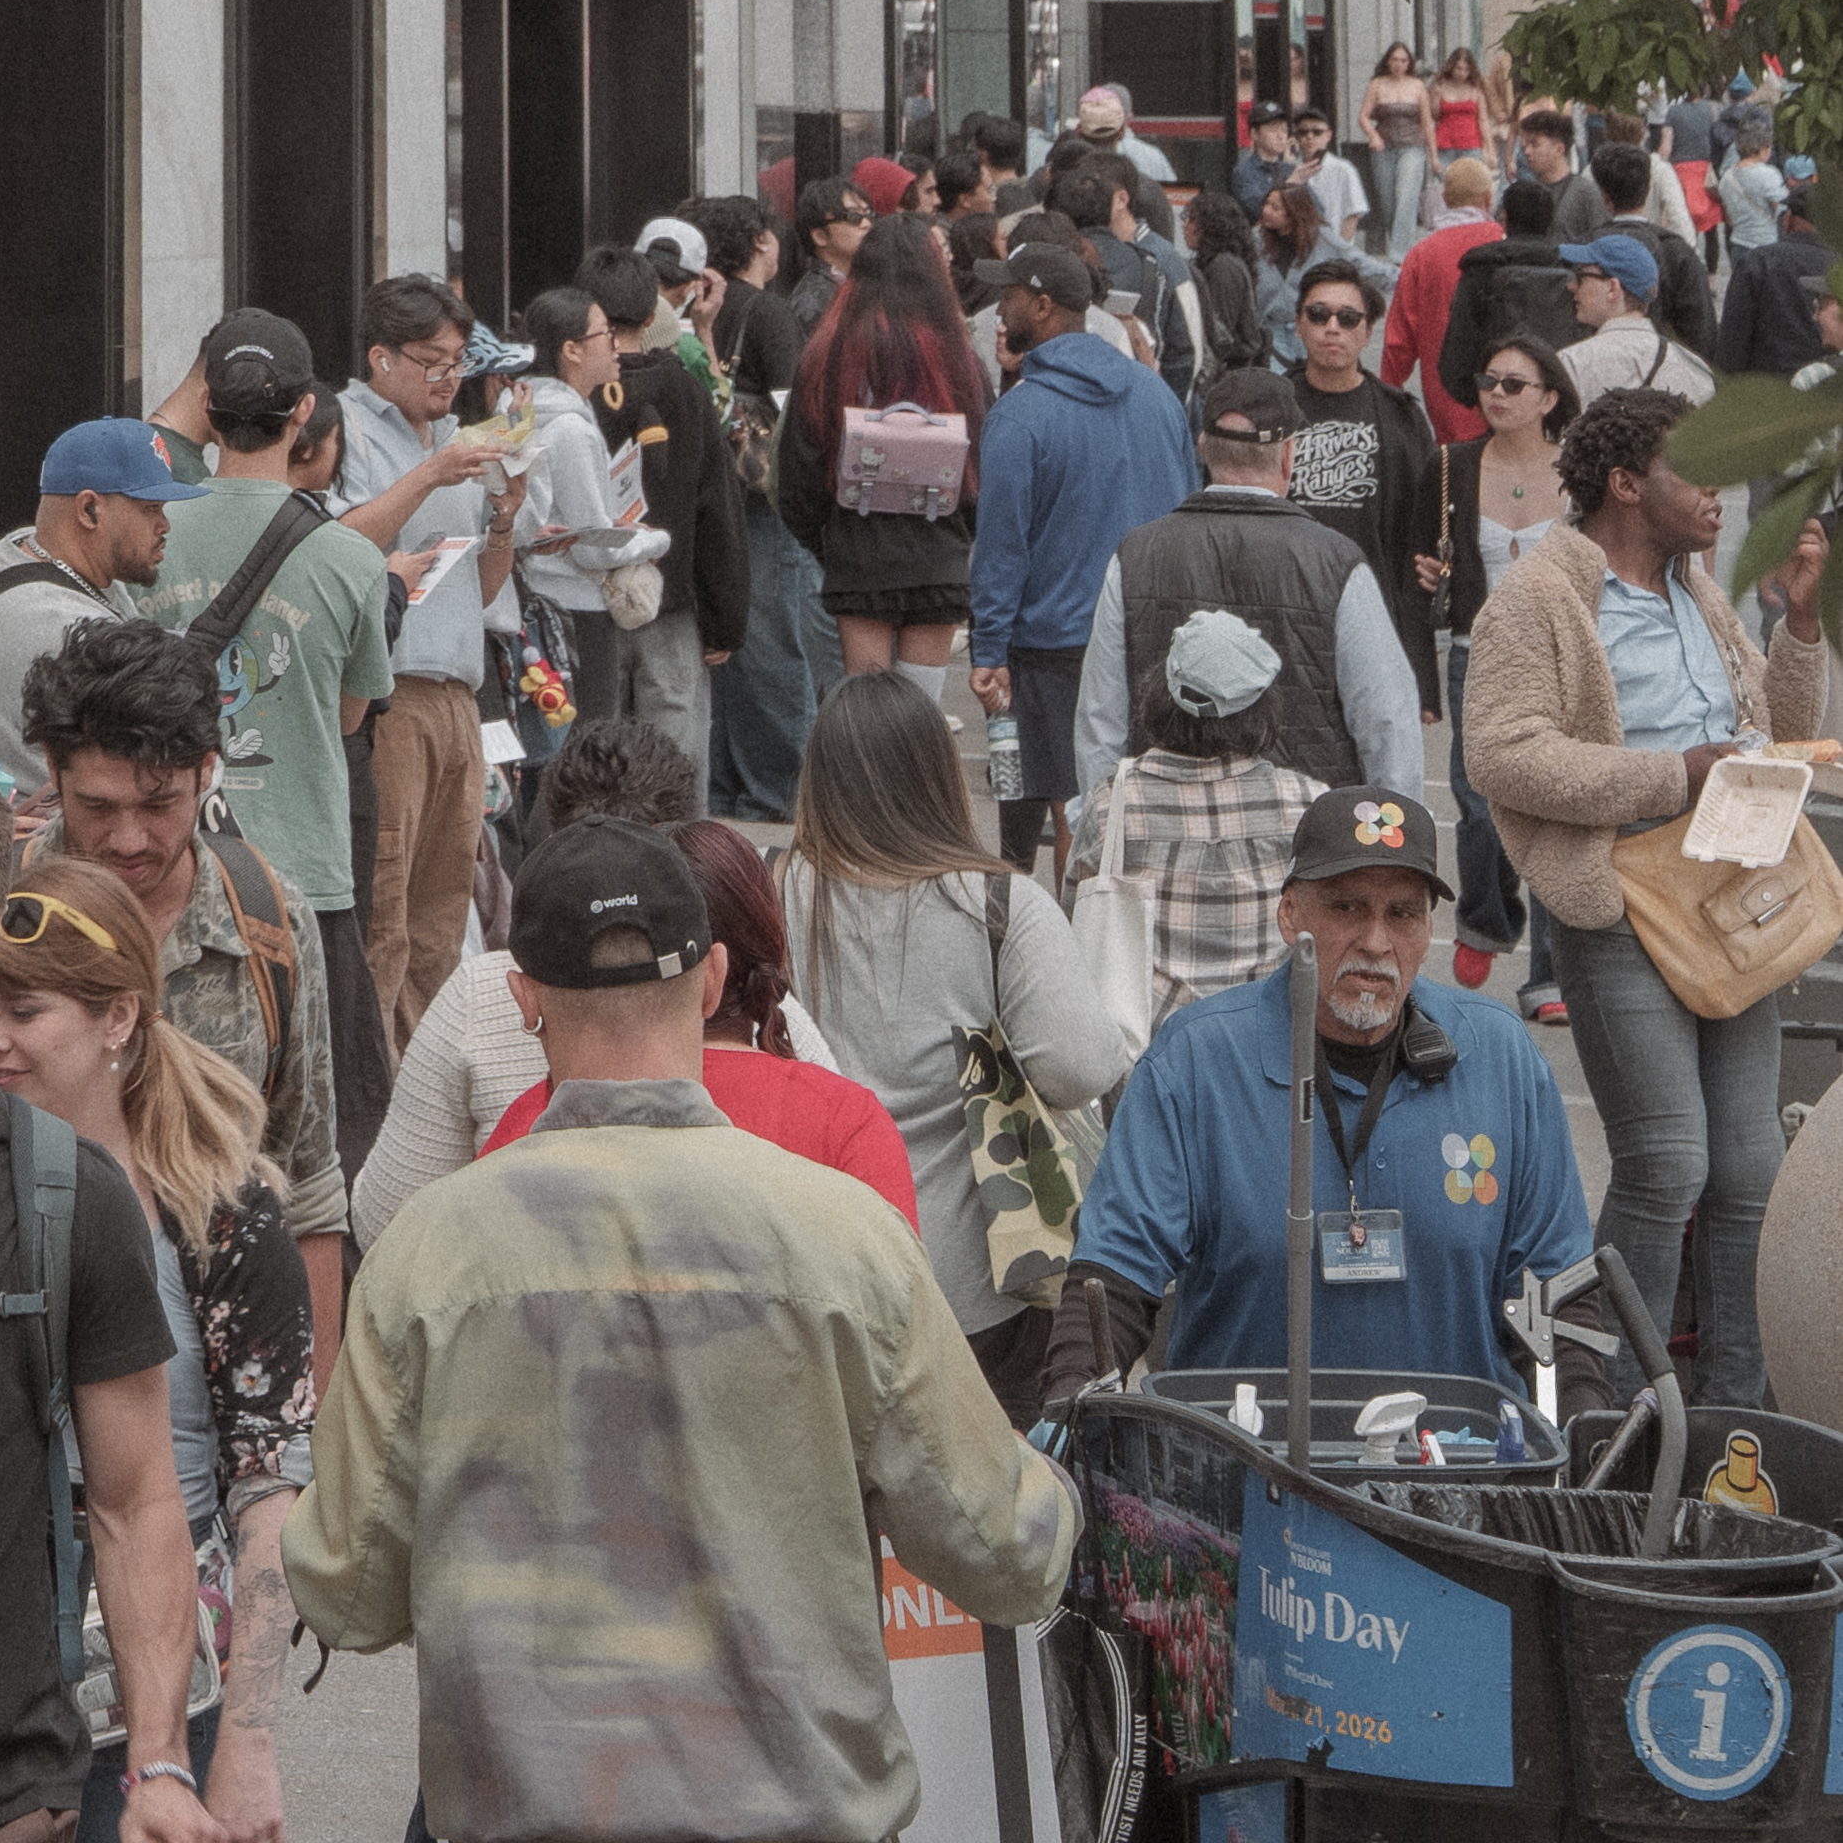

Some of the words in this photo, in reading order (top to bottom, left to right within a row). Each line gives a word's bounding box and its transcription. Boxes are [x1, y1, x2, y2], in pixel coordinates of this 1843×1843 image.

[1291, 455, 1369, 500] Ranges
[260, 586, 311, 632] lanet
[603, 893, 638, 909] world
[883, 1583, 982, 1630] NL
[1258, 1564, 1317, 1643] Tulip
[1324, 1591, 1410, 1664] Day
[1134, 1714, 1147, 1745] ALLY
[1335, 1710, 1393, 1744] 2026
[1132, 1748, 1147, 1768] AN
[1123, 1769, 1146, 1812] NEEDS
[1114, 1813, 1135, 1843] TIST
